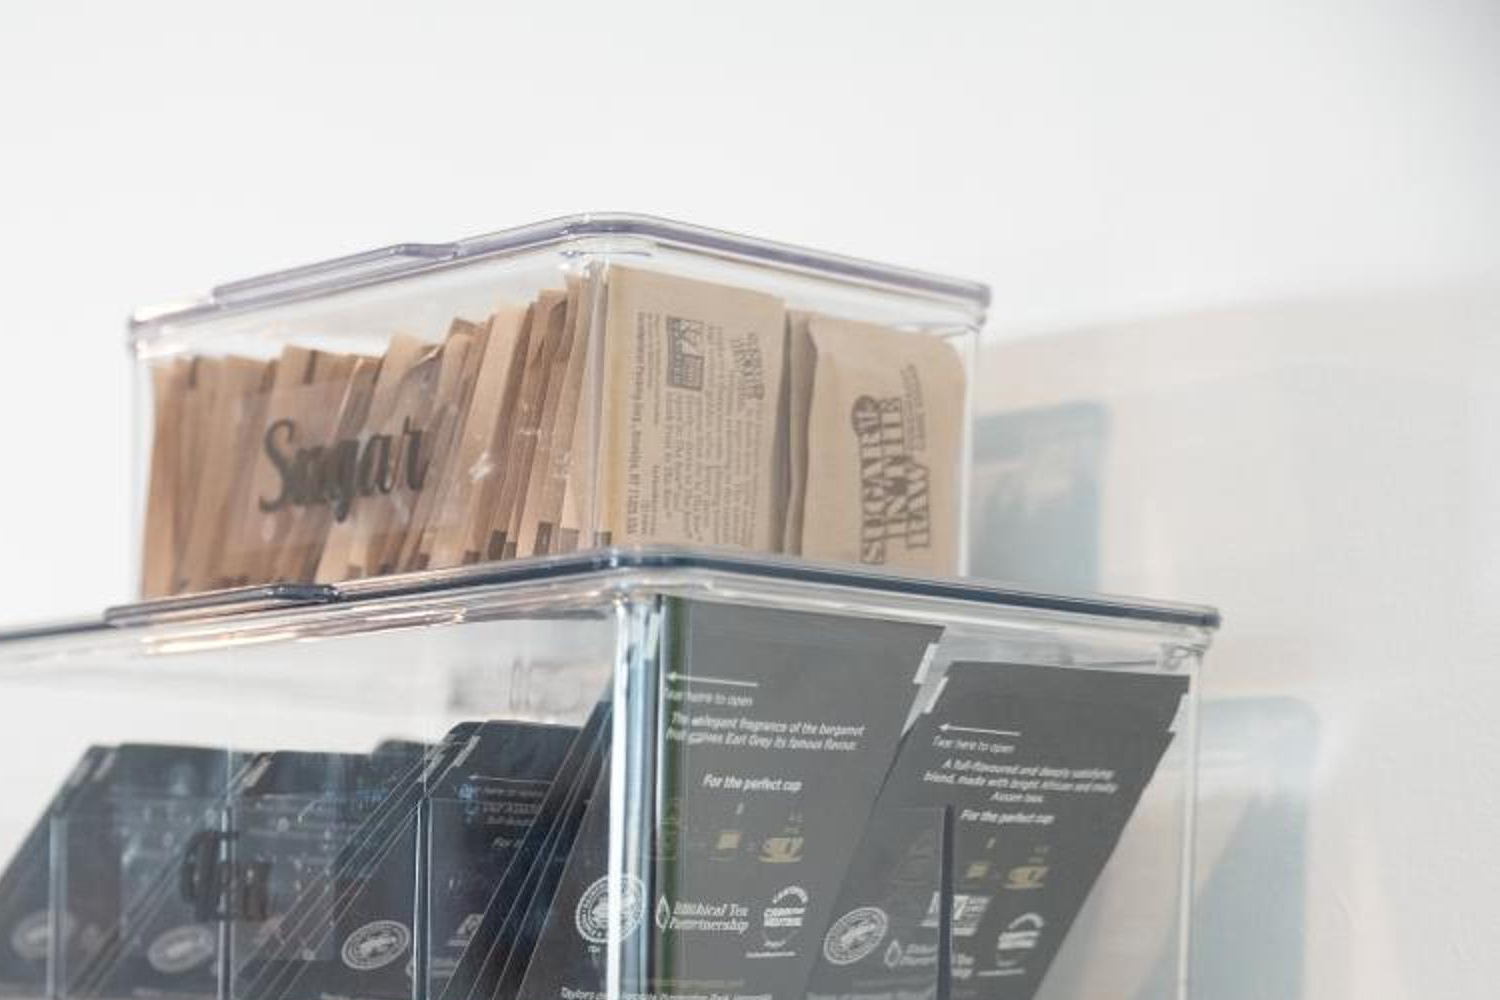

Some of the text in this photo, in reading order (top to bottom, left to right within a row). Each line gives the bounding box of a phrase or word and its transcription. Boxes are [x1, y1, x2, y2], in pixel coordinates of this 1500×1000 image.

[259, 416, 424, 522] Sugar
[703, 773, 723, 788] For
[723, 775, 742, 789] the
[742, 777, 783, 791] perfect
